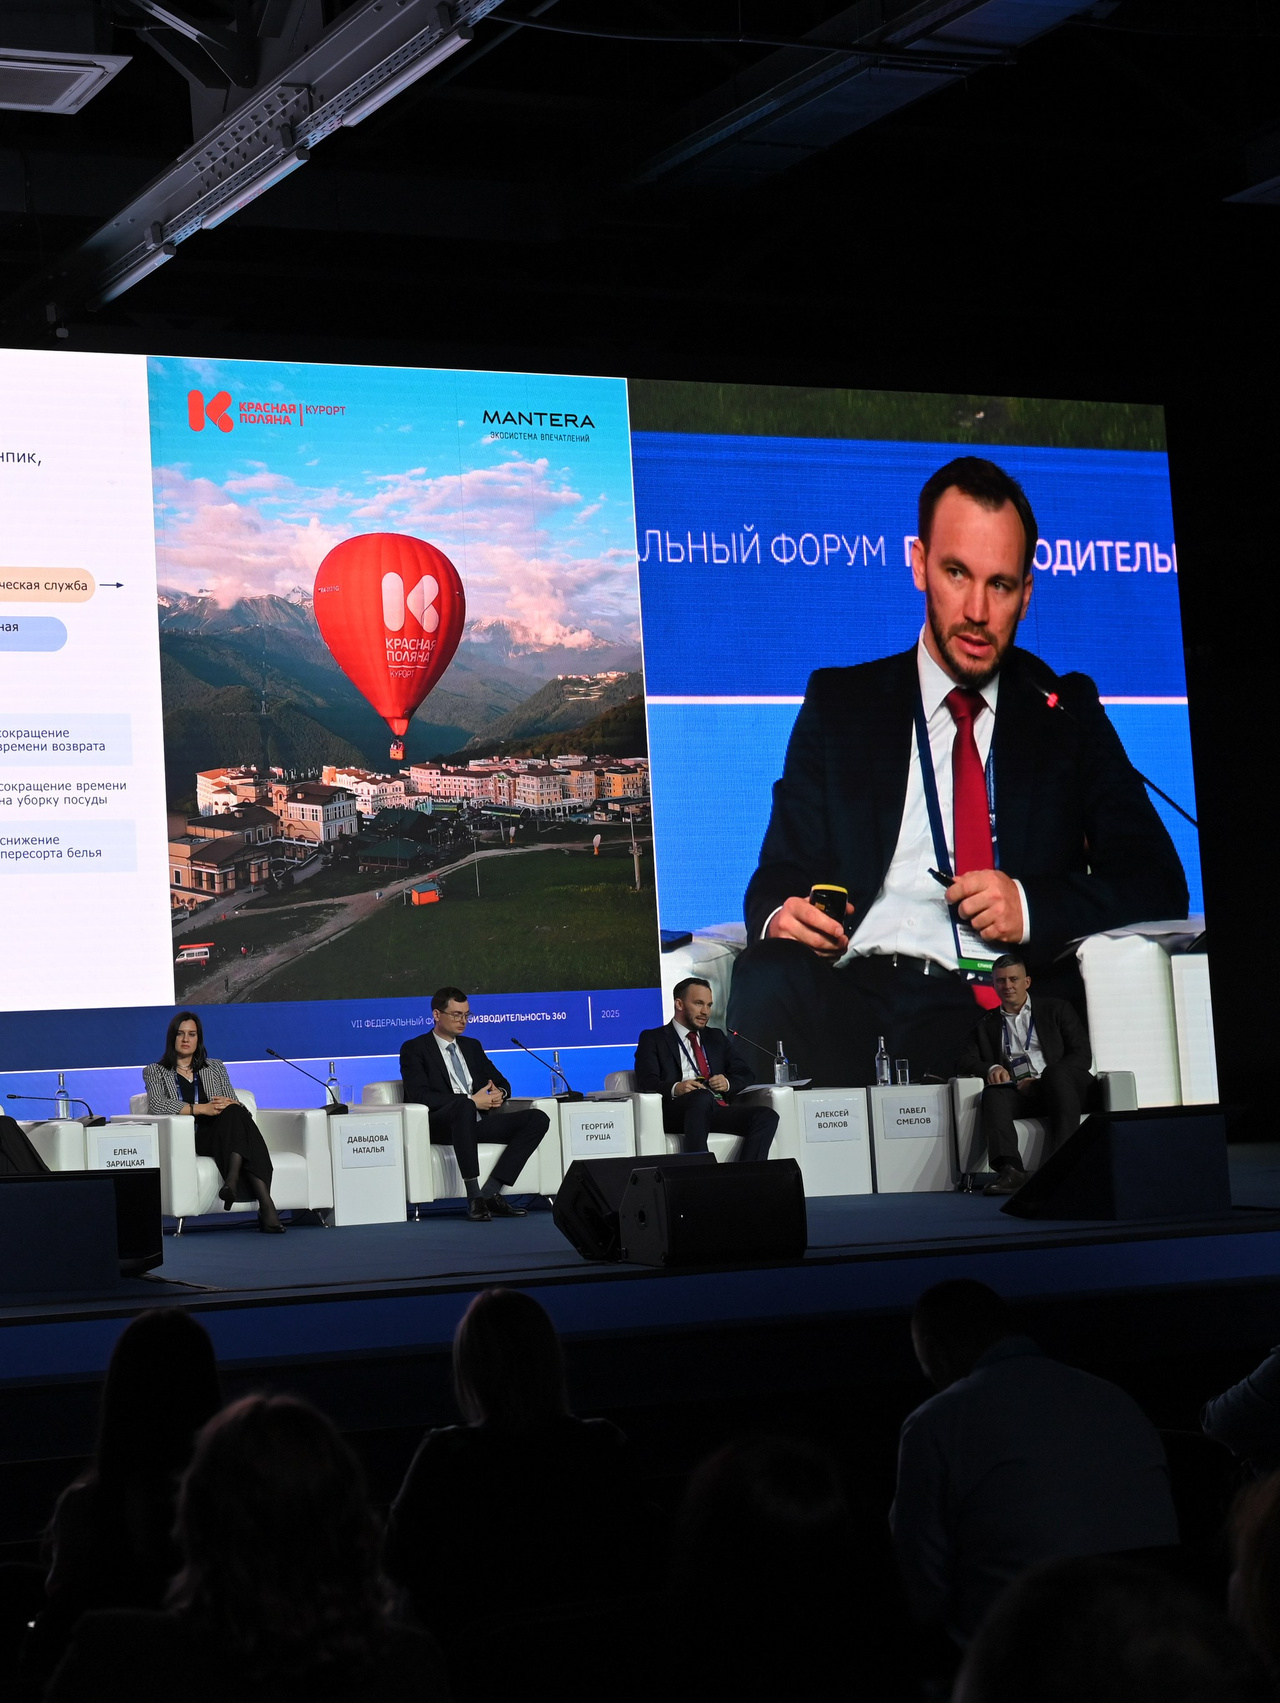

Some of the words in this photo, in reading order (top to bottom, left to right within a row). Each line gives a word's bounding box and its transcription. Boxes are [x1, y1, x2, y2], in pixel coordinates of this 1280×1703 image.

[239, 401, 297, 414] КРАСНАЯ
[305, 405, 346, 416] КУРОРТ
[239, 413, 292, 426] ПОЛЯНА
[482, 410, 596, 429] MANTERA
[490, 431, 538, 441] ЭКОСИСТЕМА
[540, 433, 590, 443] ВПЕЧАТЛЕНИЙ
[637, 523, 761, 565] ЛЬНЫЙ
[770, 532, 886, 567] ФОРУМ
[44, 580, 88, 593] служба
[385, 637, 437, 651] КРАСНАЯ
[386, 650, 430, 663] ПОЛЯНА
[389, 669, 415, 679] КУРОРТ
[52, 743, 105, 753] возврата
[76, 782, 126, 793] времени
[17, 795, 59, 807] уборку
[64, 796, 107, 806] посуды
[0, 837, 59, 845] снижение
[0, 850, 63, 861] пересорта
[67, 847, 102, 858] белья
[467, 1012, 551, 1024] ОИЗВОДИТЕЛЬНОСТЬ
[552, 1011, 567, 1020] 360
[601, 1009, 620, 1019] 2025
[363, 1015, 424, 1028] ФЕДЕРАЛЬНЫЙ
[815, 1108, 849, 1118] АЛЕКСЕЙ
[899, 1106, 927, 1115] ПАВЕЛ
[581, 1121, 614, 1131] ГЕОРГИЙ
[817, 1121, 848, 1129] ВОЛКОВ
[896, 1117, 932, 1126] СМЕЛОВ
[346, 1134, 389, 1144] ДАВЫДОВА
[585, 1133, 611, 1141] ГРУША
[113, 1148, 138, 1156] ЕЛЕНА
[352, 1146, 385, 1154] НАТАЛЬЯ
[105, 1158, 145, 1168] ЗАРИЦКАЯ
